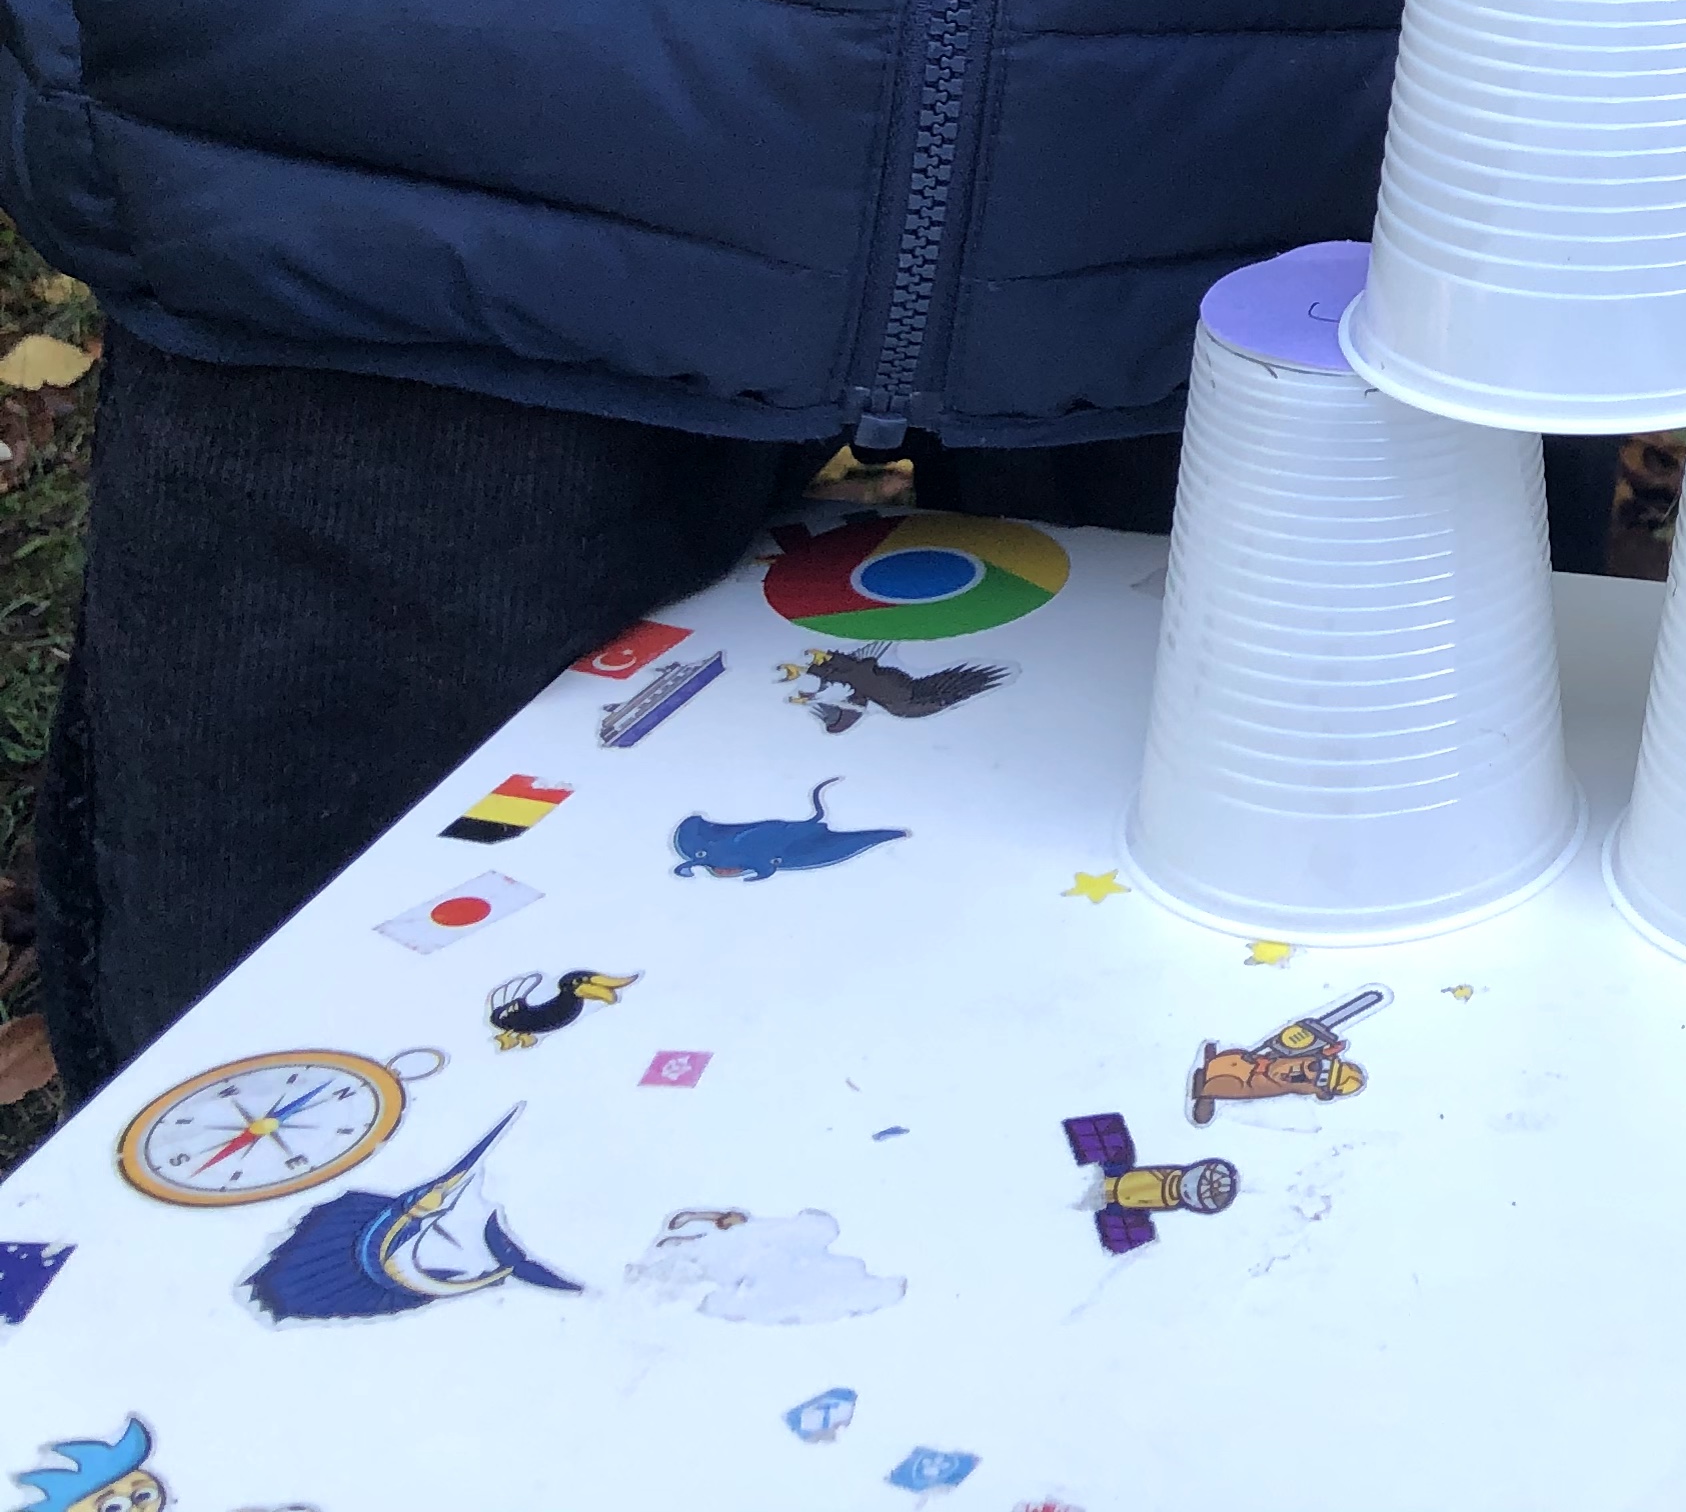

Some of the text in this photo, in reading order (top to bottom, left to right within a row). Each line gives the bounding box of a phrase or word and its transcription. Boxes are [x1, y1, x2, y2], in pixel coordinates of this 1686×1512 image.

[332, 1086, 357, 1101] N
[169, 1152, 191, 1168] S
[284, 1153, 309, 1171] E
